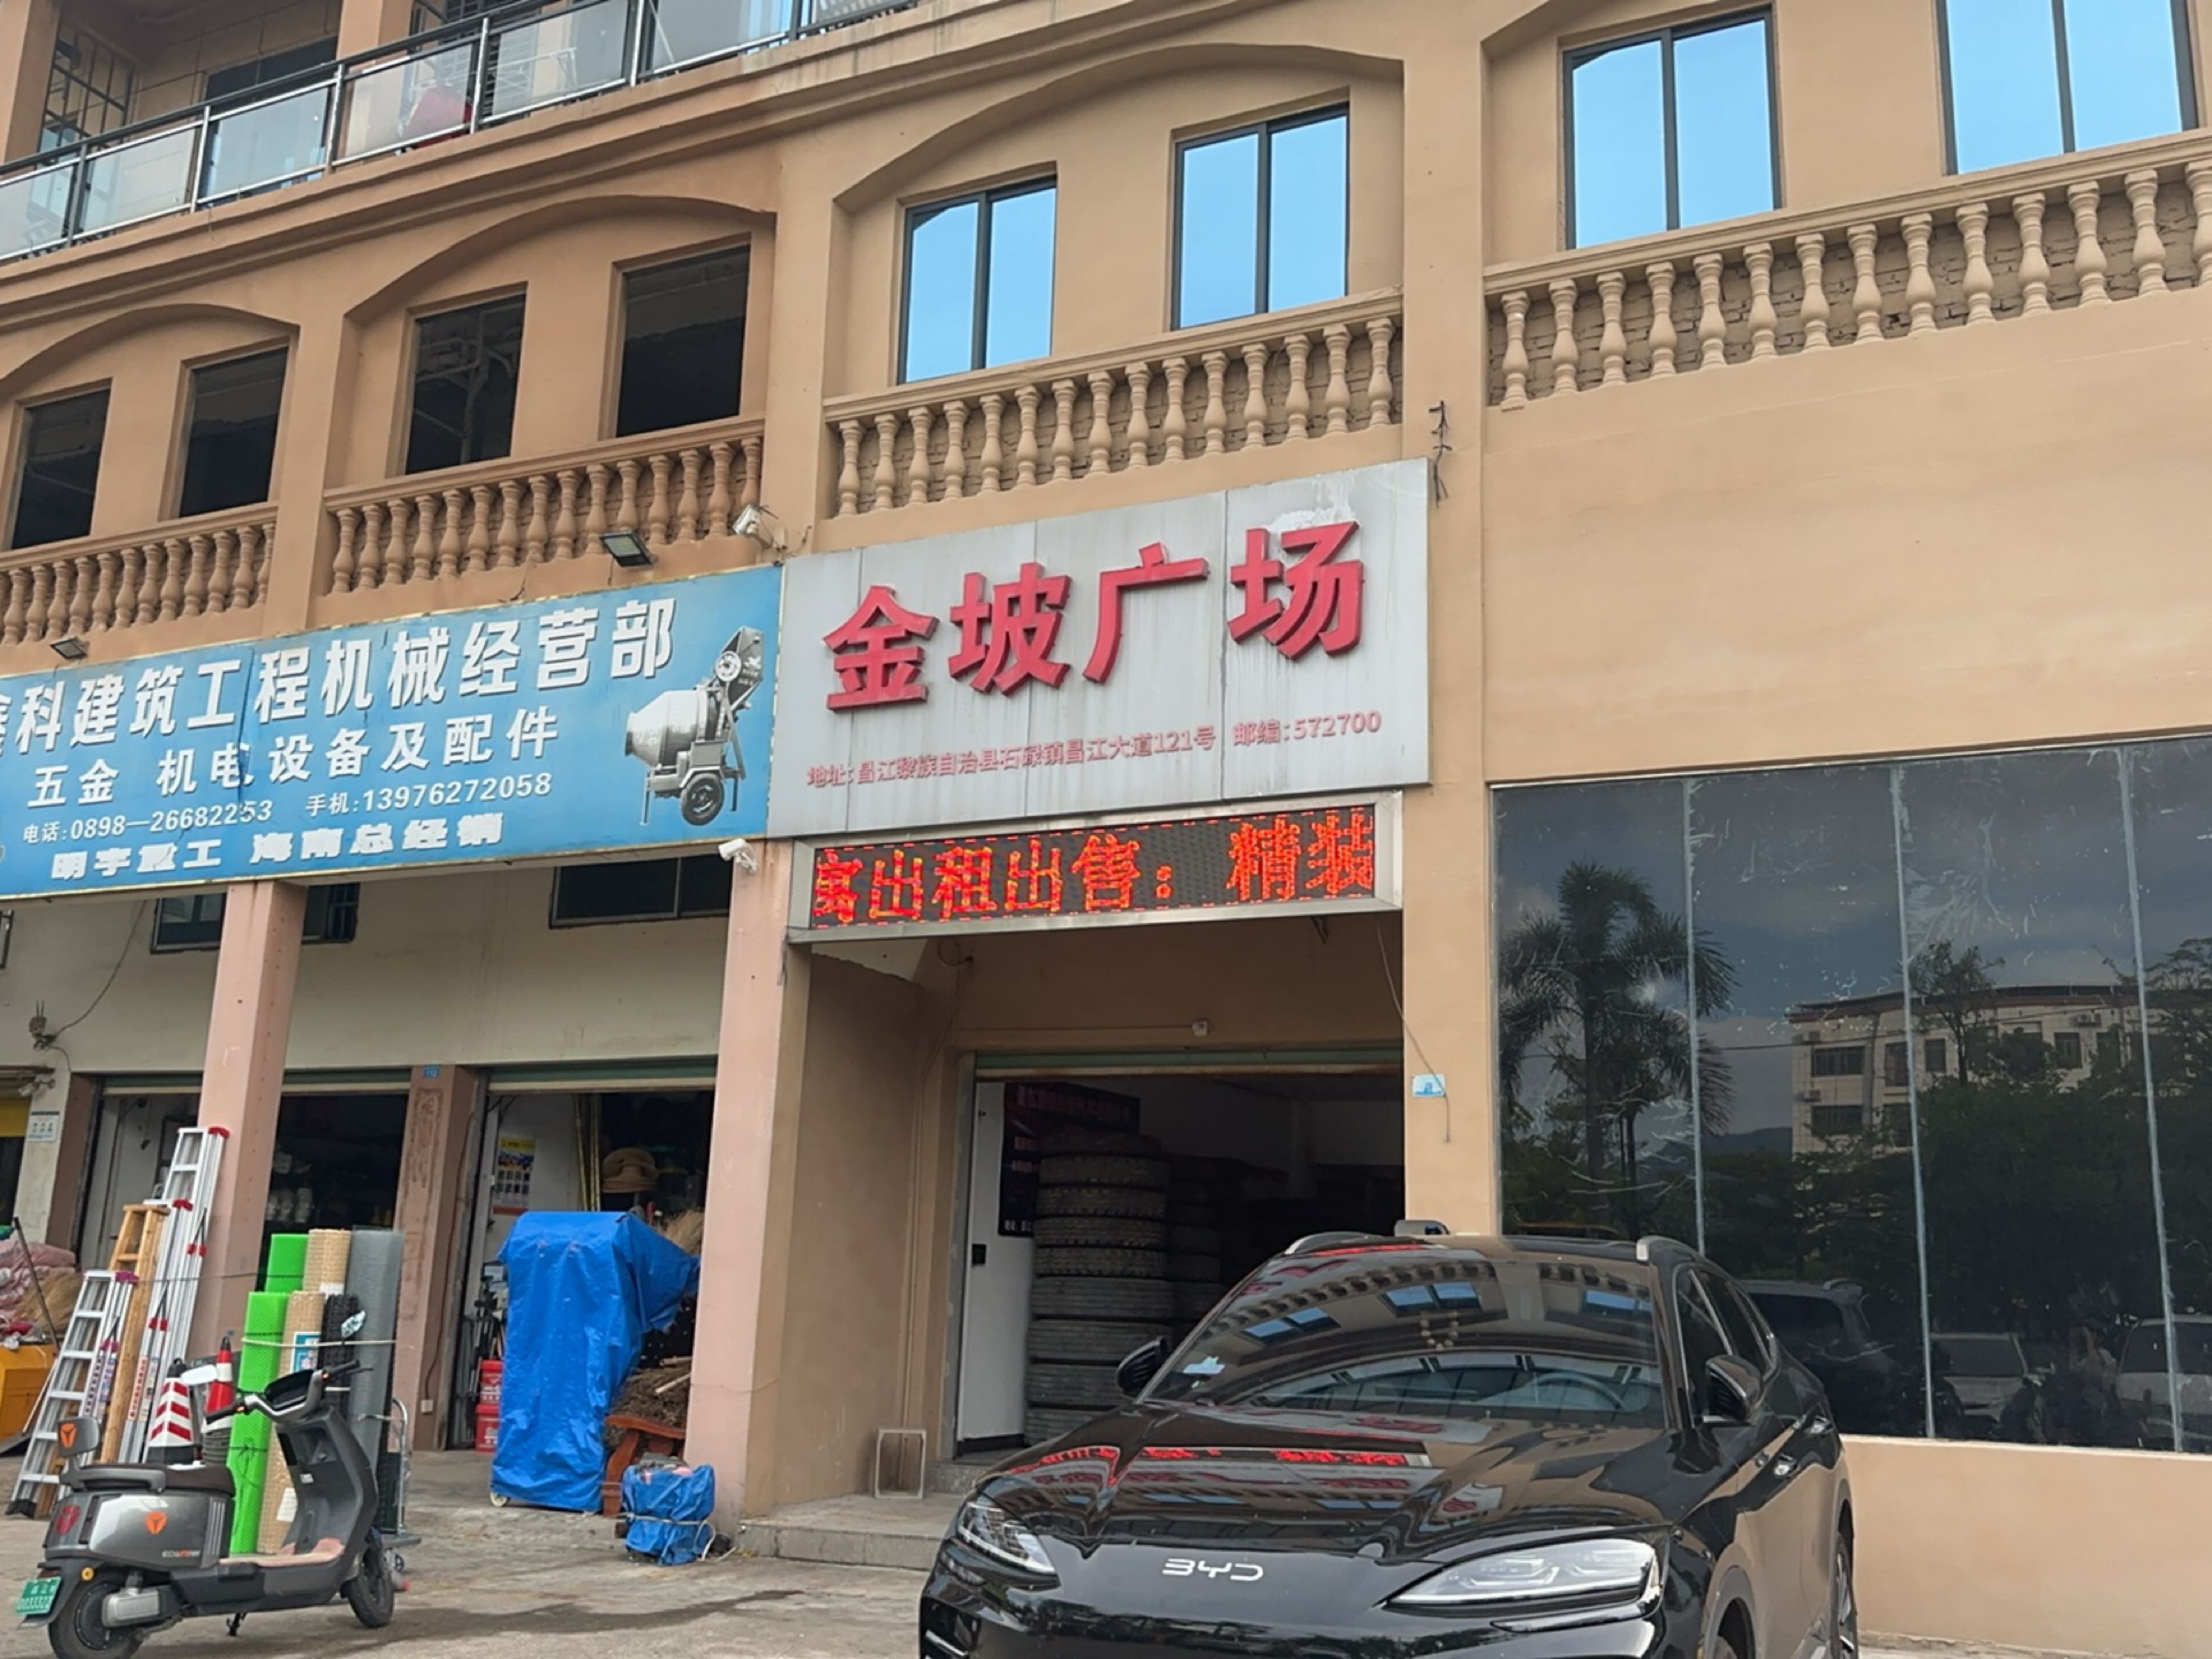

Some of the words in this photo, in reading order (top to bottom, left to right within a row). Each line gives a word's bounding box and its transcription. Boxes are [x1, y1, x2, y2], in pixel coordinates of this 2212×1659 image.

[822, 520, 1364, 713] 金坡广场
[0, 599, 676, 756] 科建筑工程机械经营部
[28, 758, 119, 808] 五金
[156, 707, 558, 797] 机电设备及配件
[1232, 710, 1382, 746] 邮编:572700
[305, 773, 552, 818] 手机:13976272058
[1162, 1558, 1264, 1582] BYD
